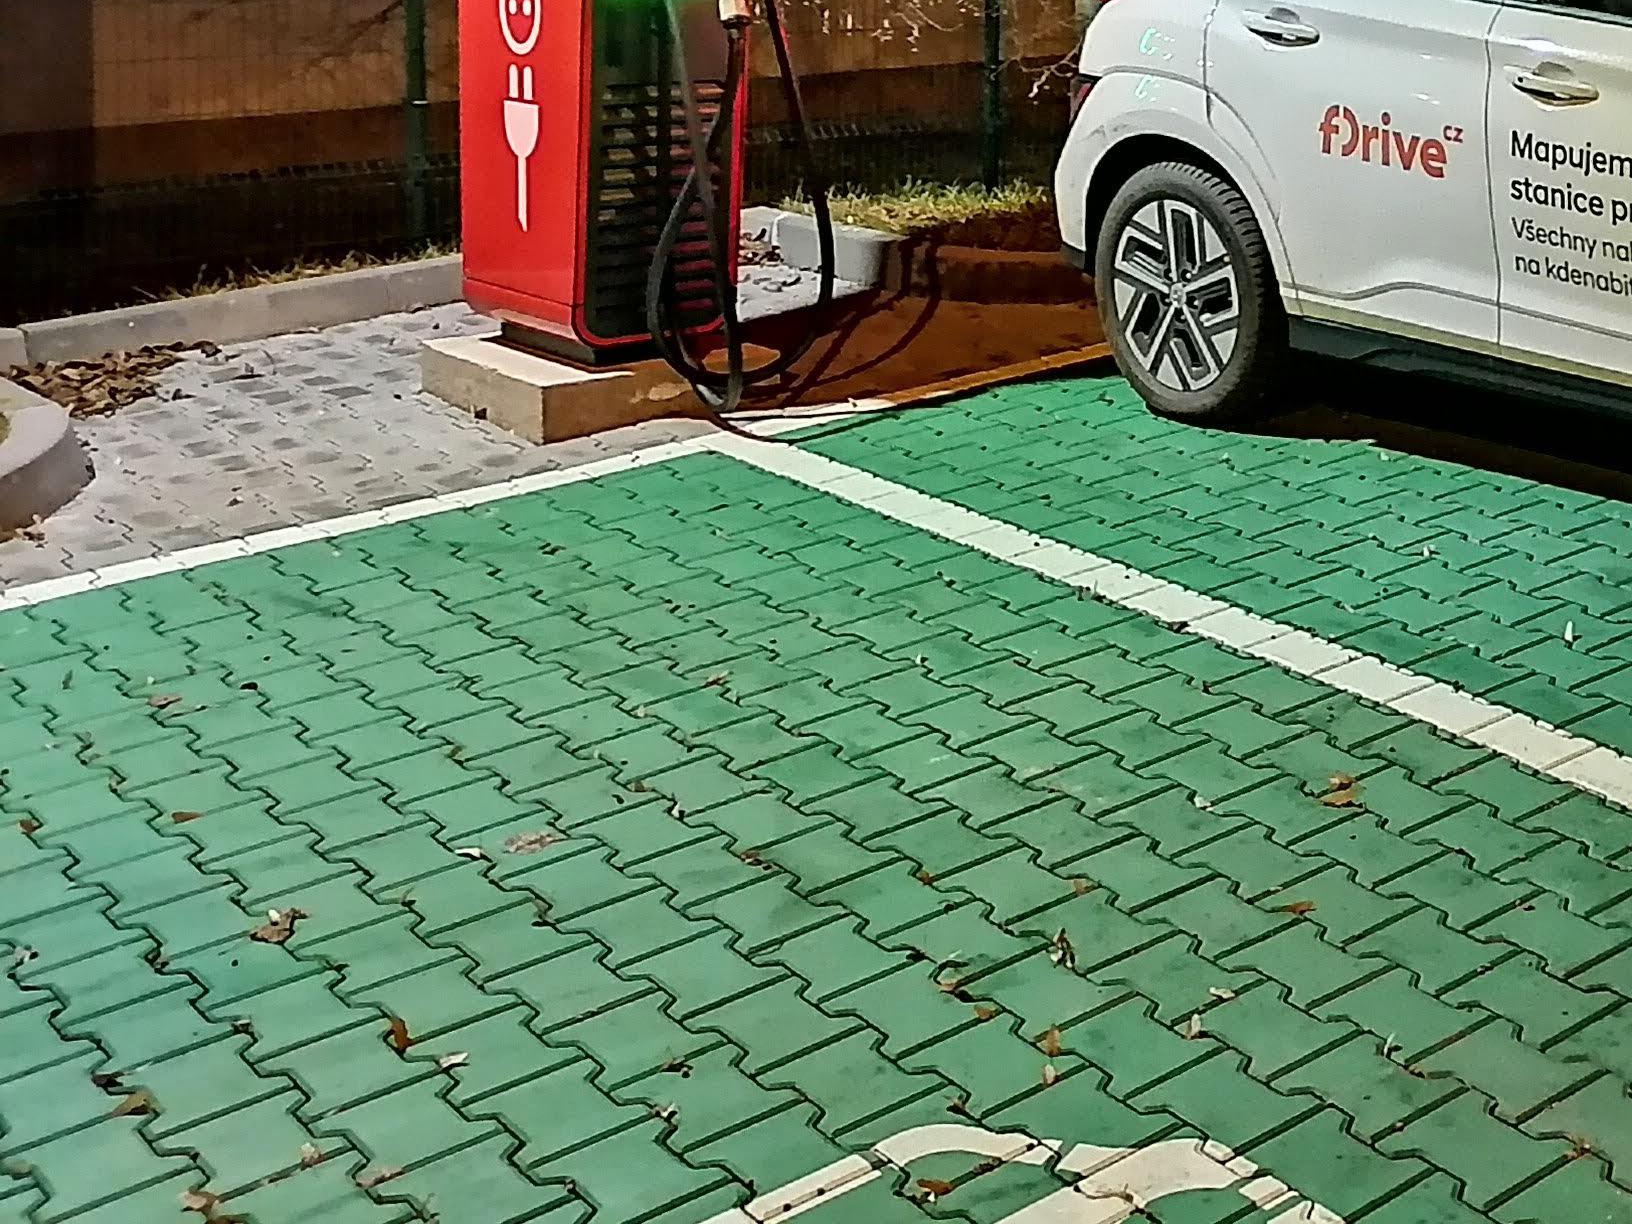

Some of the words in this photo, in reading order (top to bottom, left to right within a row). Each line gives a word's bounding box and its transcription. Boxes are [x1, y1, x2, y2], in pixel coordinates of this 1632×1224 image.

[1510, 177, 1605, 216] stanice
[1511, 216, 1598, 260] Všechny
[1514, 255, 1541, 276] na
